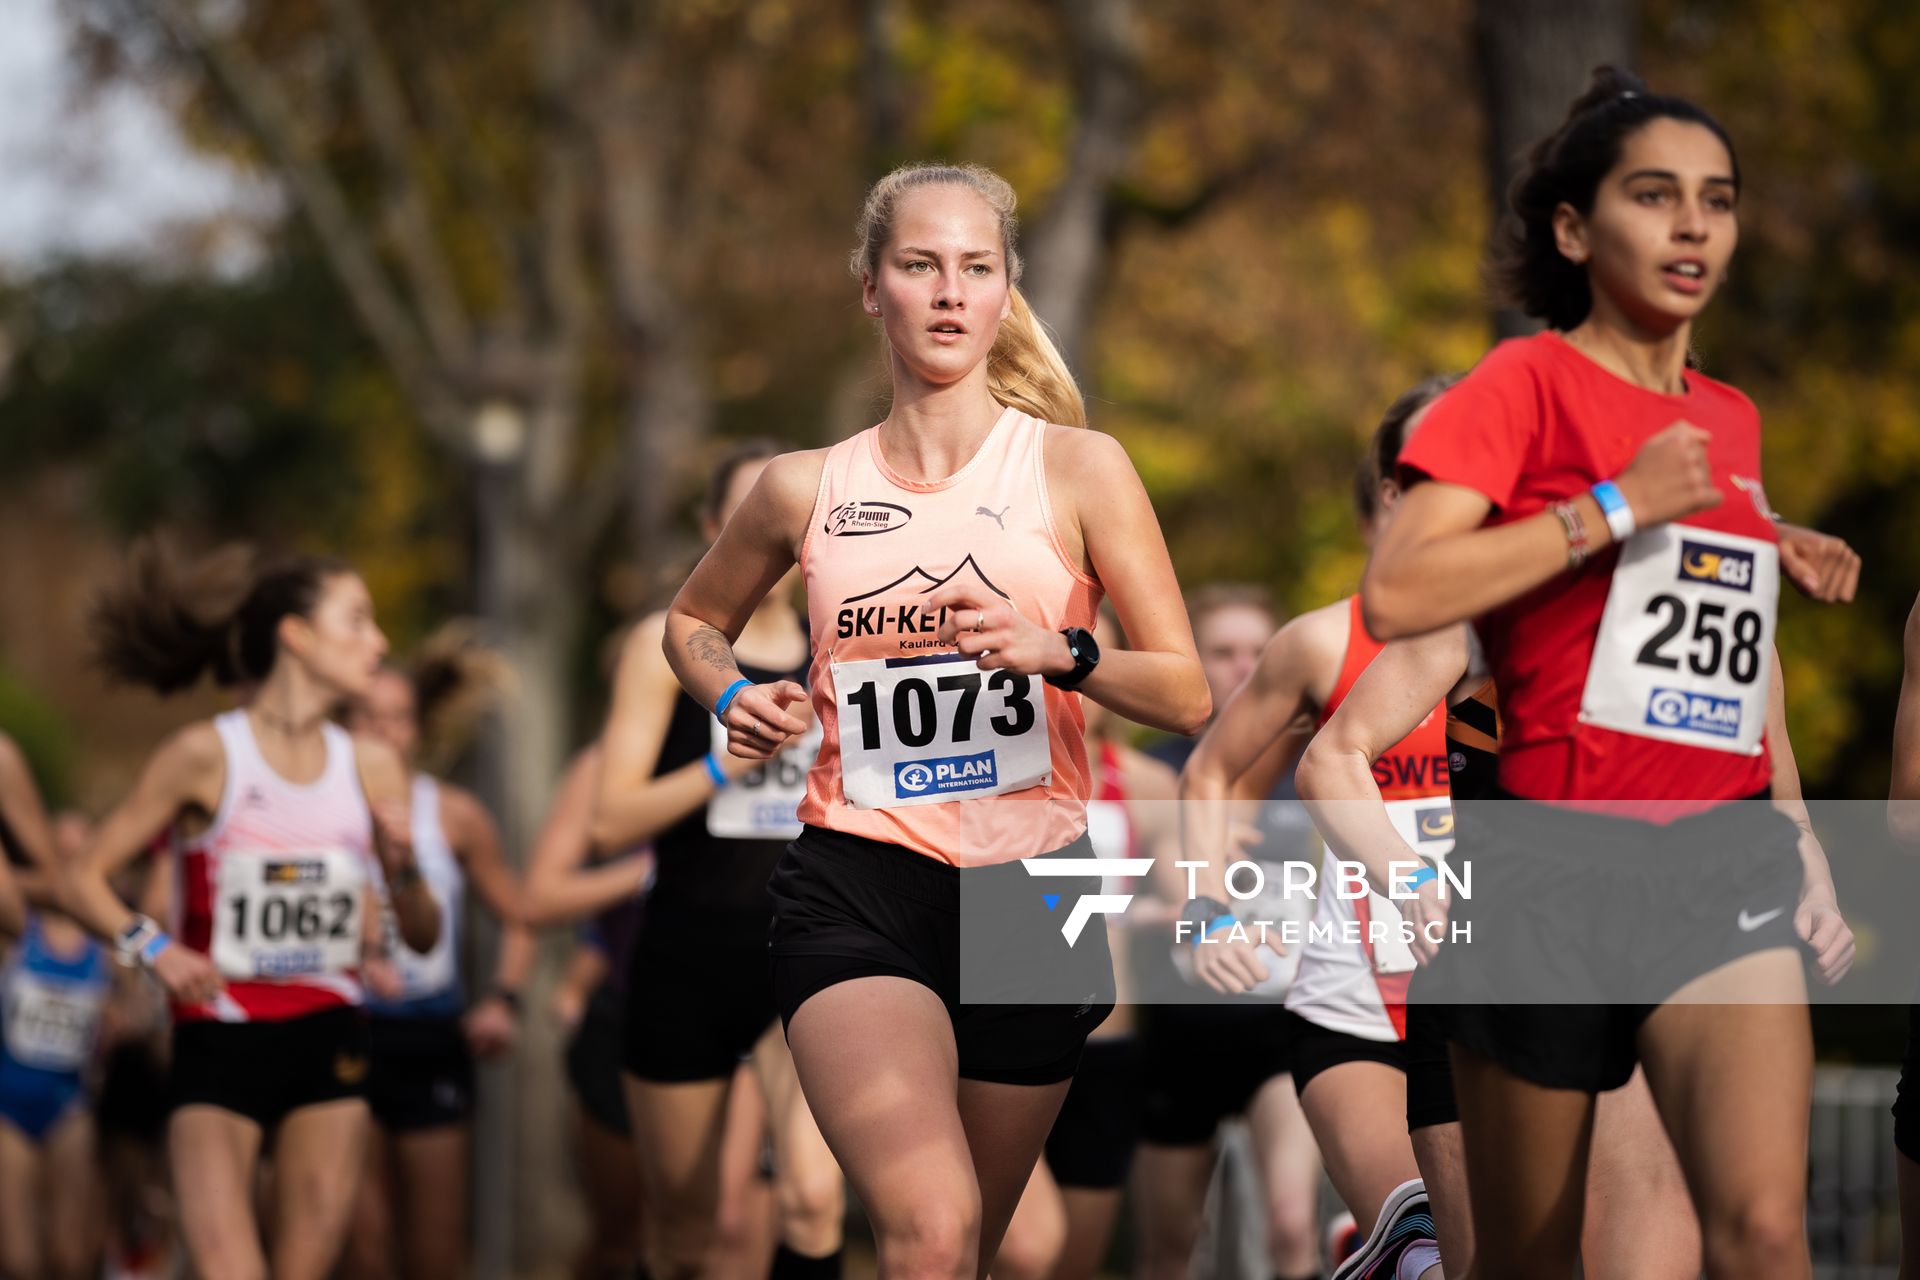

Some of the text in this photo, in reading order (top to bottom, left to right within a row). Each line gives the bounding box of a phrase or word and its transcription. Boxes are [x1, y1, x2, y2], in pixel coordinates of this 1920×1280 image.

[851, 520, 888, 529] Rhein-Sieg
[857, 510, 890, 521] PUMA
[900, 639, 946, 649] Kaulard
[1636, 594, 1761, 685] 258
[847, 668, 1035, 751] 1073
[1690, 696, 1739, 725] PLAN
[936, 759, 993, 780] PLAN
[938, 777, 993, 789] INTERNATIONAL
[229, 890, 354, 940] 1062
